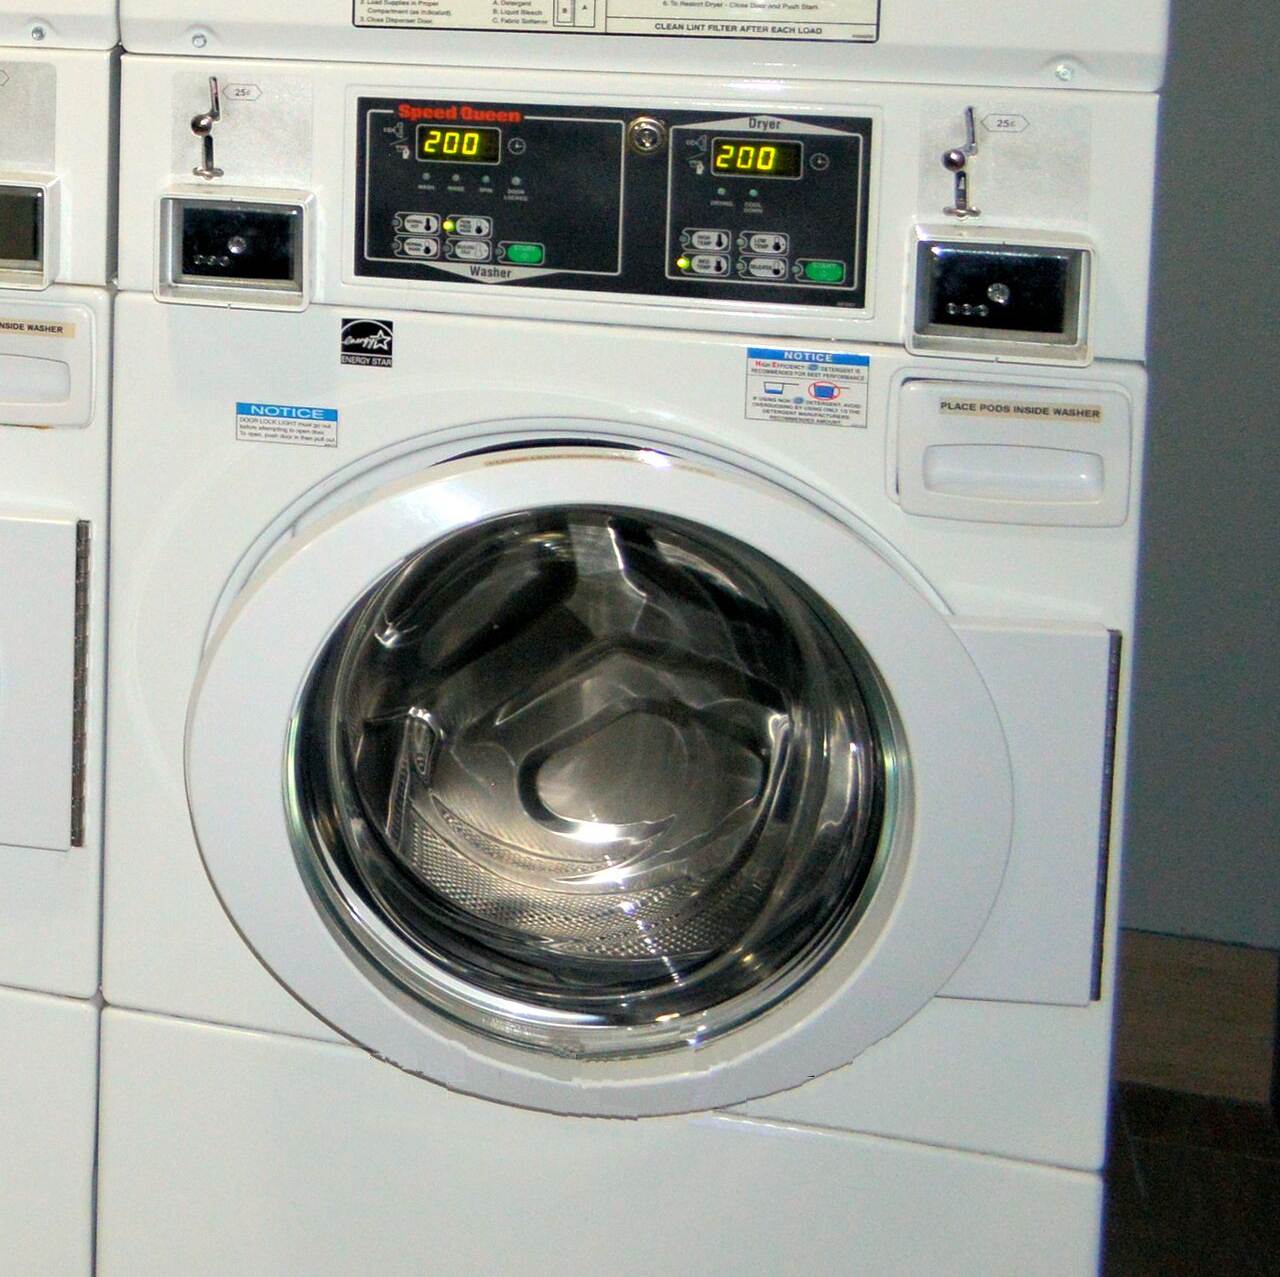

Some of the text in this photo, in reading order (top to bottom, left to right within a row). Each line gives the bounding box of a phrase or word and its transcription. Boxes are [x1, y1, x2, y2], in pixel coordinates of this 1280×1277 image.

[687, 23, 706, 31] LINT
[708, 24, 737, 32] FILTER
[740, 25, 768, 33] AFTER
[771, 26, 795, 34] EACH
[798, 27, 822, 35] LOAD
[399, 104, 521, 122] Speed Queen
[749, 118, 781, 130] Dryer
[424, 131, 479, 155] 200
[716, 145, 776, 170] 200
[470, 266, 511, 278] Washer
[27, 323, 63, 333] WASHER
[342, 355, 392, 366] ENERGY STAR
[784, 351, 832, 362] NOTICE
[251, 405, 324, 419] NOTICE
[940, 401, 1100, 418] PLACE PODS INSIDE WASHER
